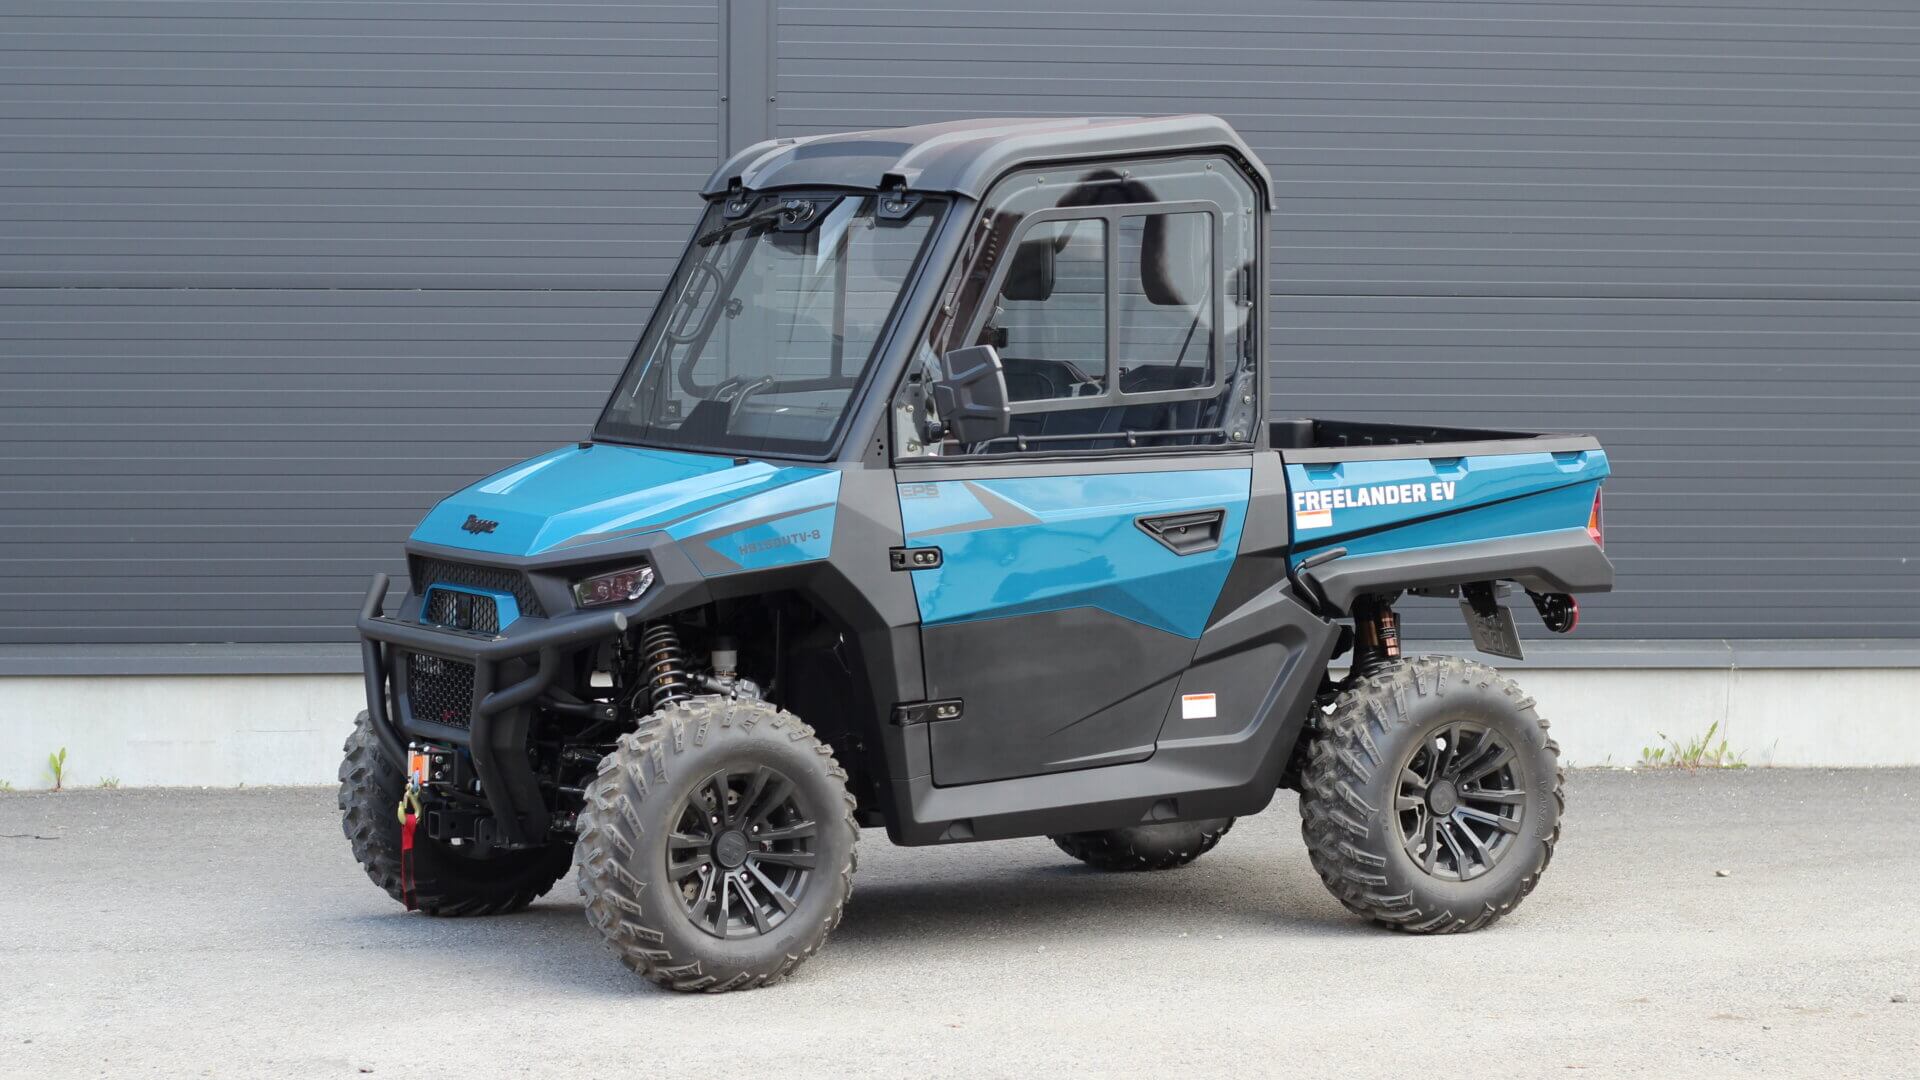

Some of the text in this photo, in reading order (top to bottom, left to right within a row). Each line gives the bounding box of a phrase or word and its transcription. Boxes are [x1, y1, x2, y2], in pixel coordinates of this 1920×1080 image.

[900, 484, 939, 497] EPS
[1294, 481, 1455, 511] FREELANDER EV
